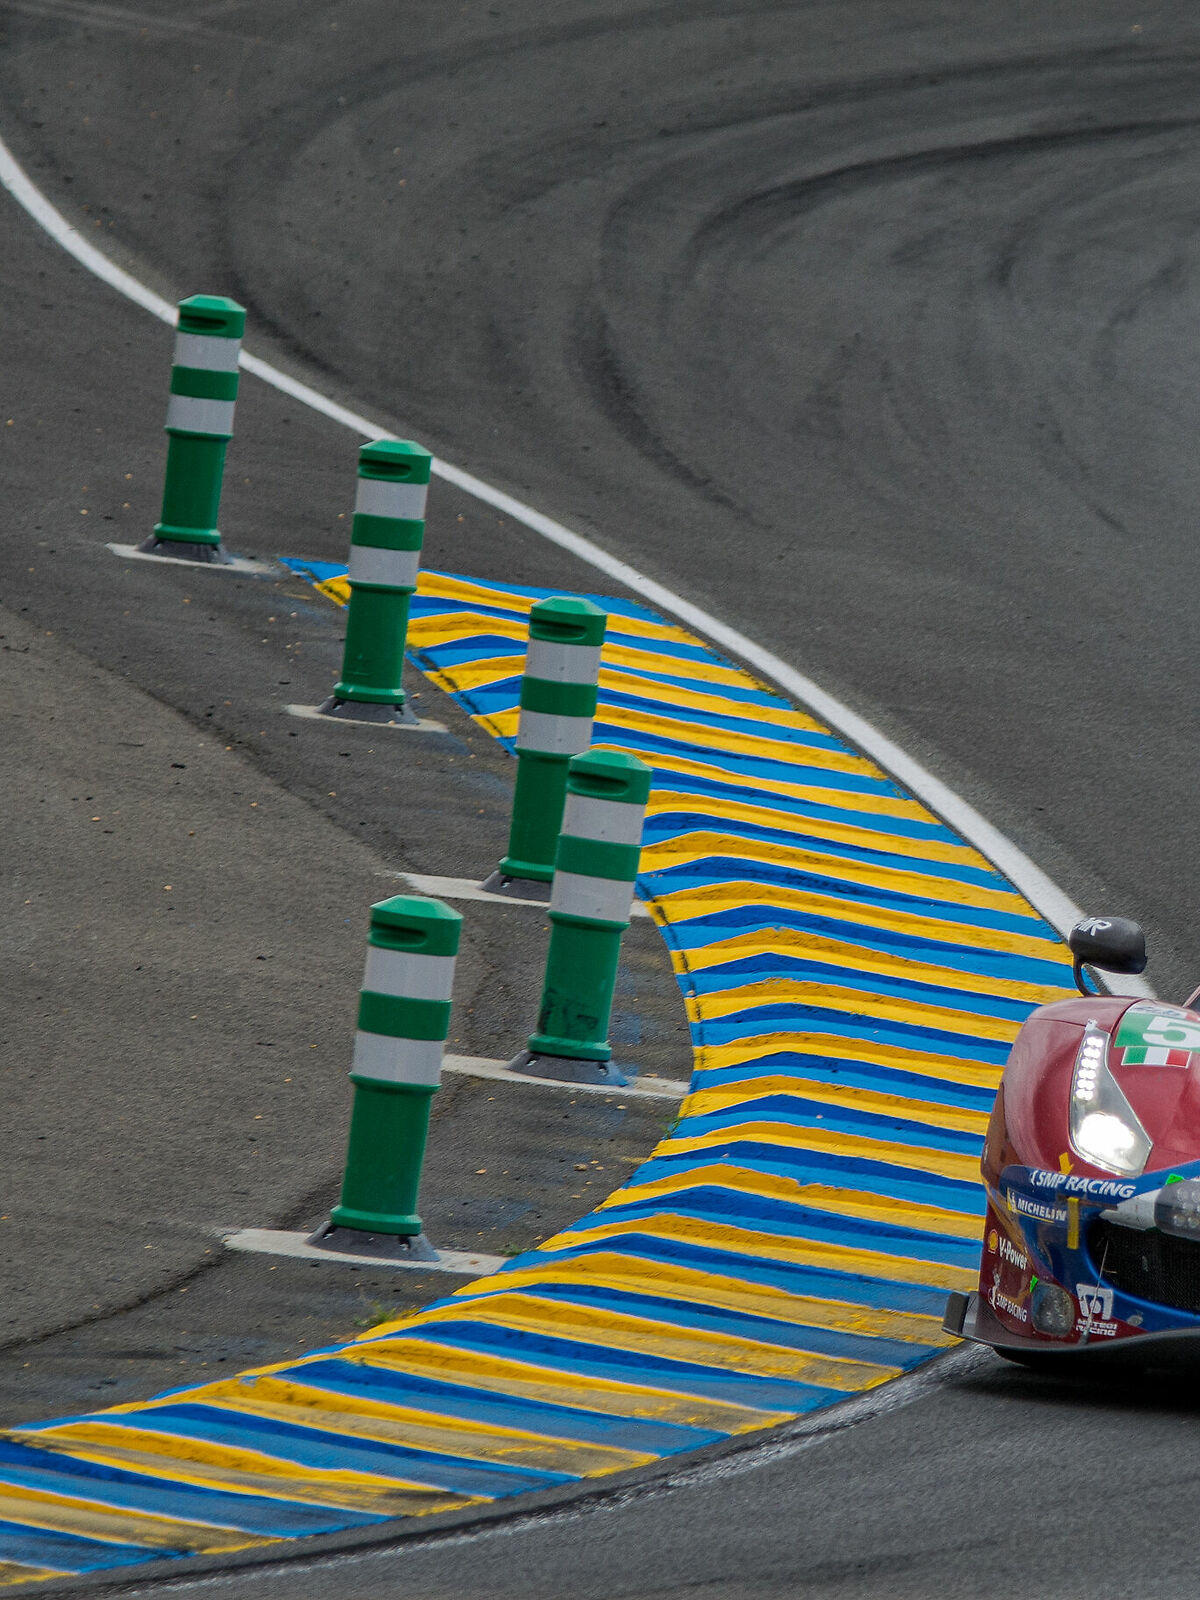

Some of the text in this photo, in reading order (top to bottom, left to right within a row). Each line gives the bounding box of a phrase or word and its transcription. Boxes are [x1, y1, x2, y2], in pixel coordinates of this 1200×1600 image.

[1036, 1169, 1136, 1199] SMP RACING
[1017, 1197, 1067, 1222] MICHELIN
[999, 1236, 1028, 1270] V-Power
